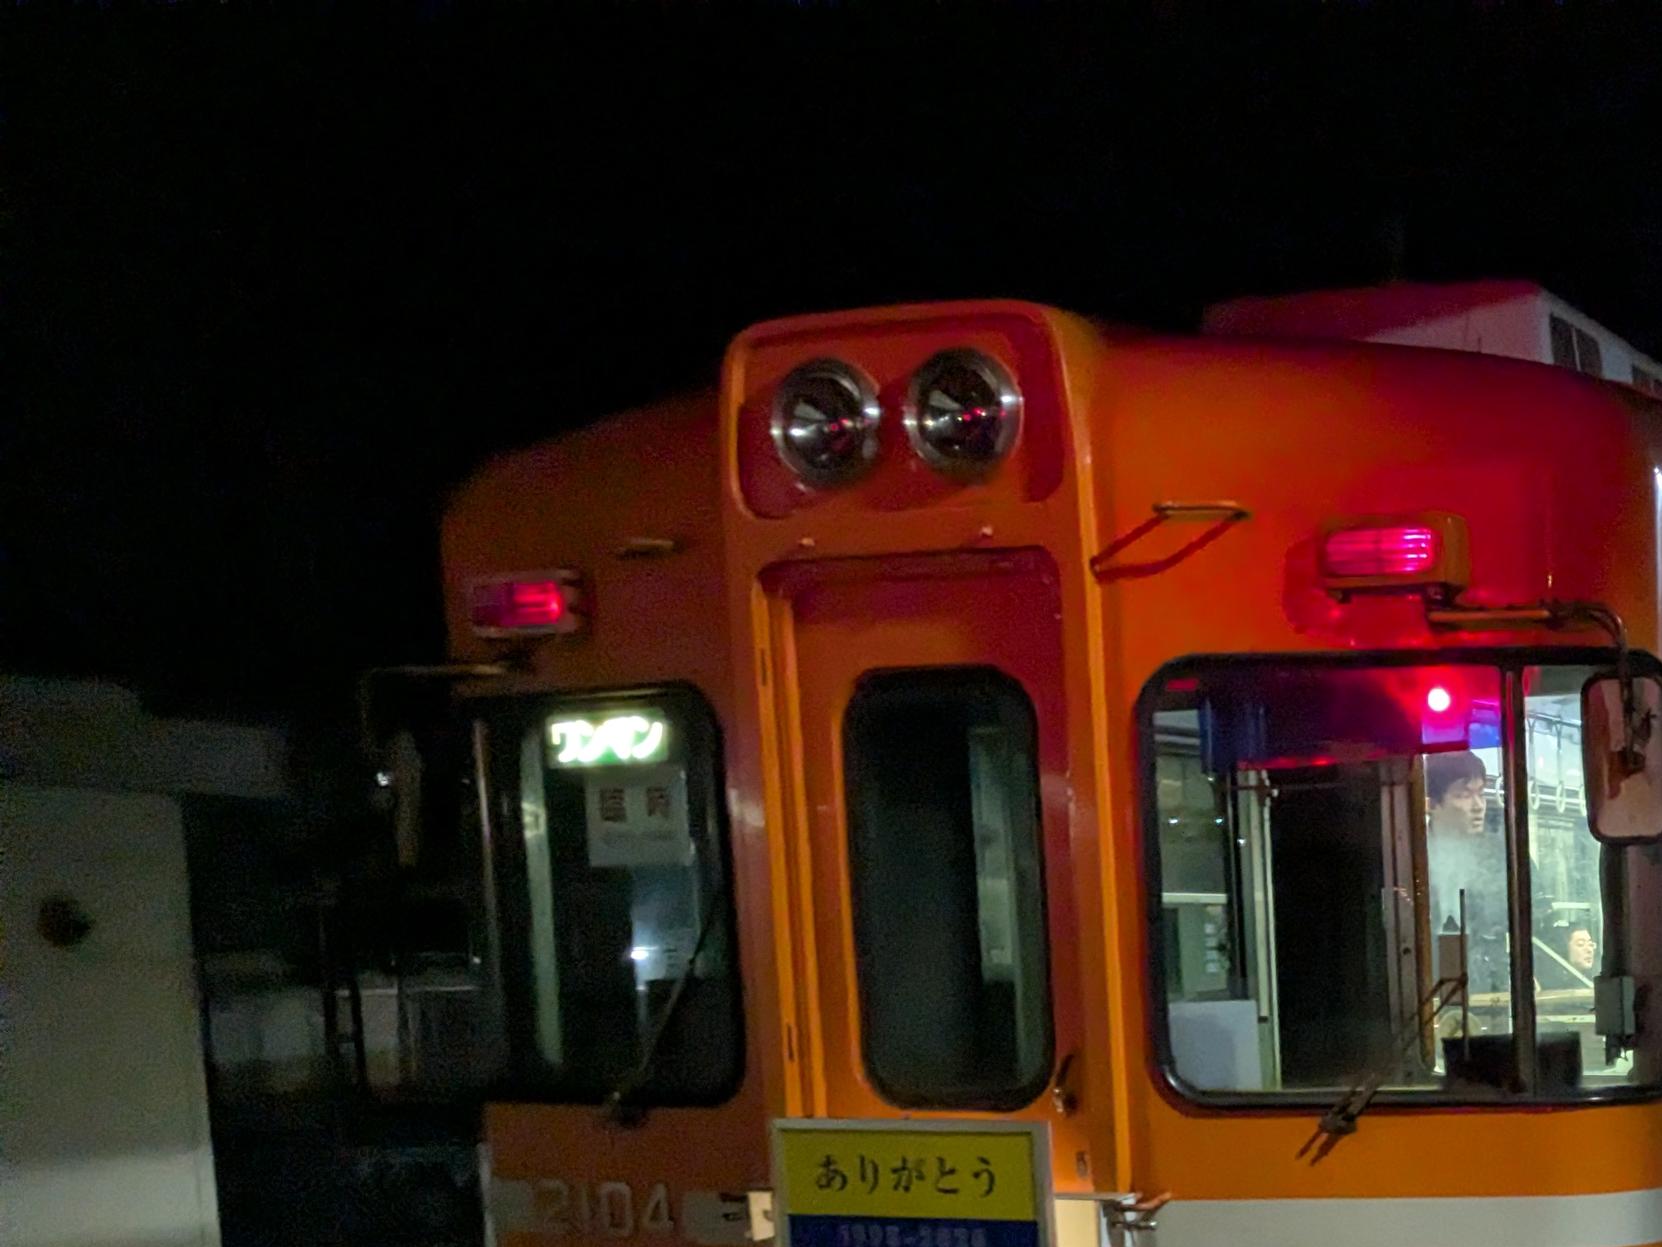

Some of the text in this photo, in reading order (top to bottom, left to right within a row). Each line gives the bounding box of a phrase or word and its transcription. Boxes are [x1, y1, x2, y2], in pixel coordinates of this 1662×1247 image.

[551, 715, 664, 763] ワンマン
[815, 1154, 997, 1196] ありがとう
[535, 1178, 674, 1238] 2104
